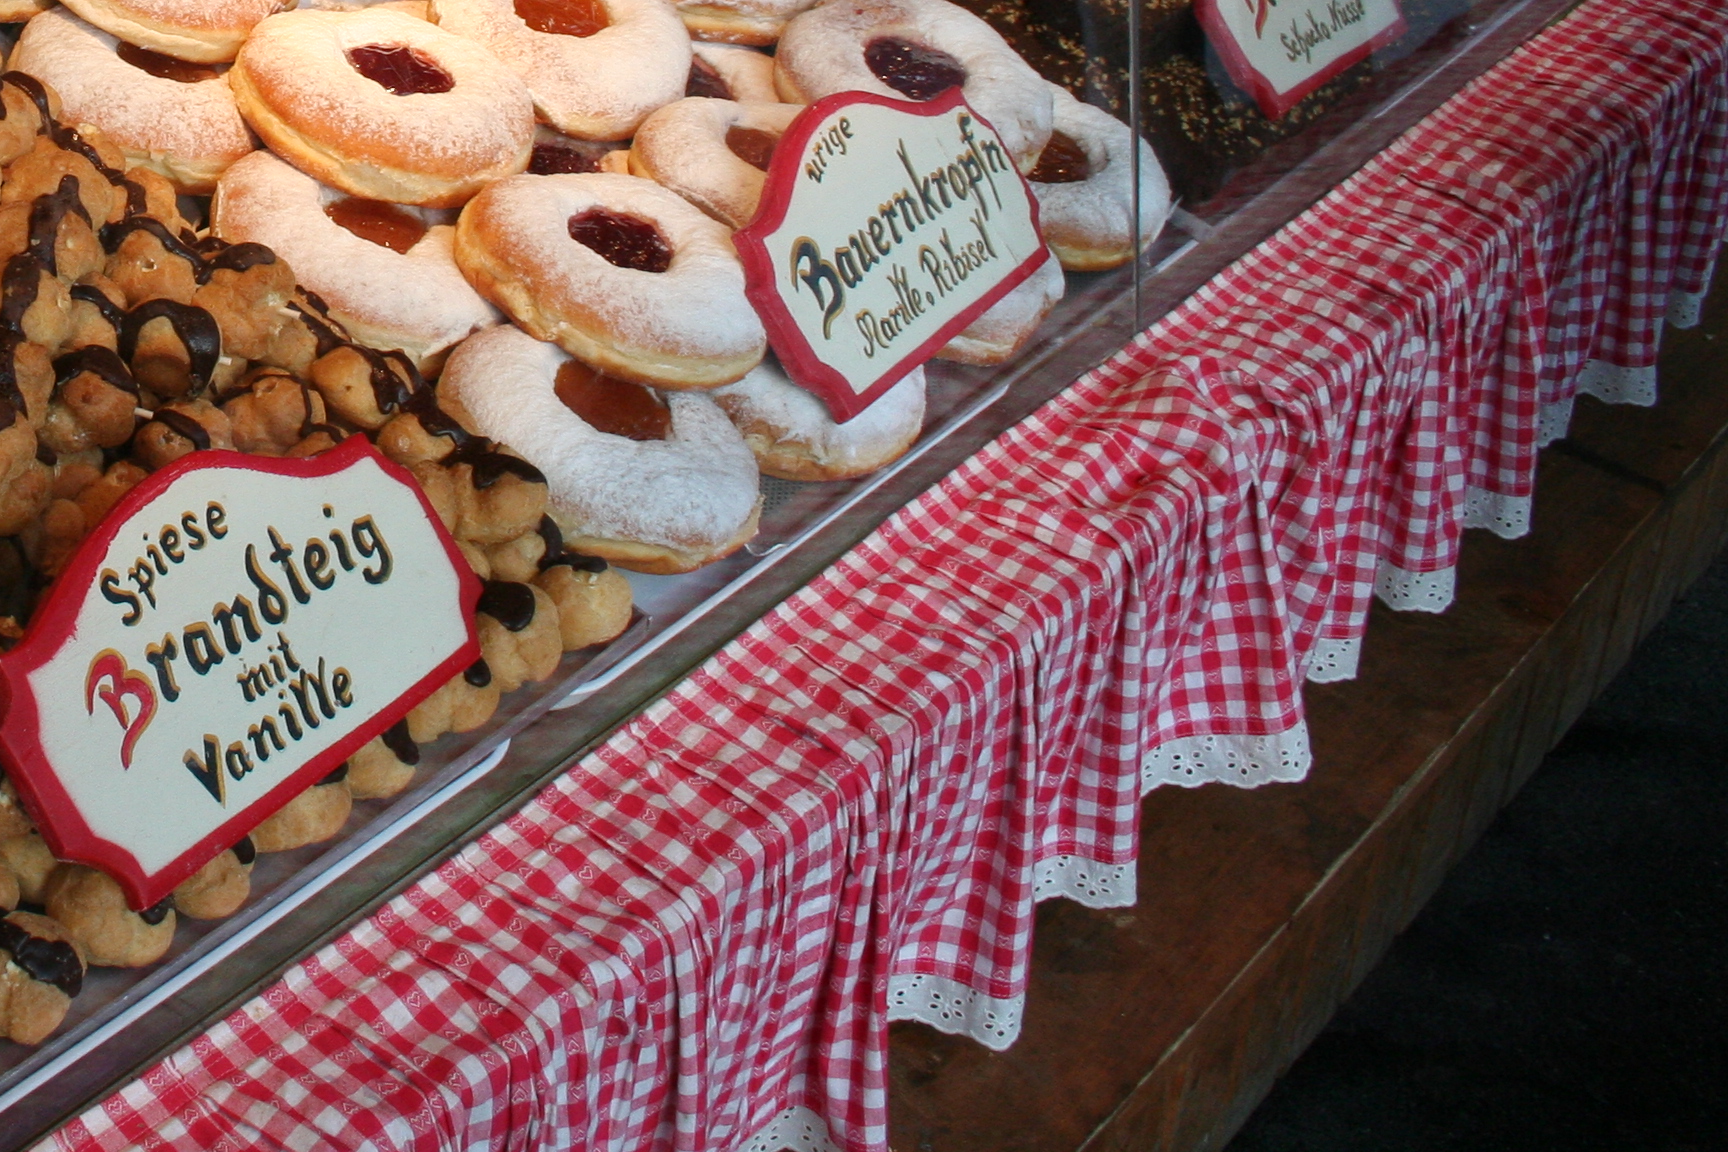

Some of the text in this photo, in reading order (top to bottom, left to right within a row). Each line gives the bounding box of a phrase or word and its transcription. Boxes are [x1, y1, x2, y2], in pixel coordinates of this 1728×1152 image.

[805, 116, 854, 183] urige
[918, 208, 998, 297] Ribisel
[100, 500, 228, 626] Spiese
[84, 503, 394, 770] Brandteig
[236, 631, 301, 701] mit
[183, 656, 353, 809] Vanille
